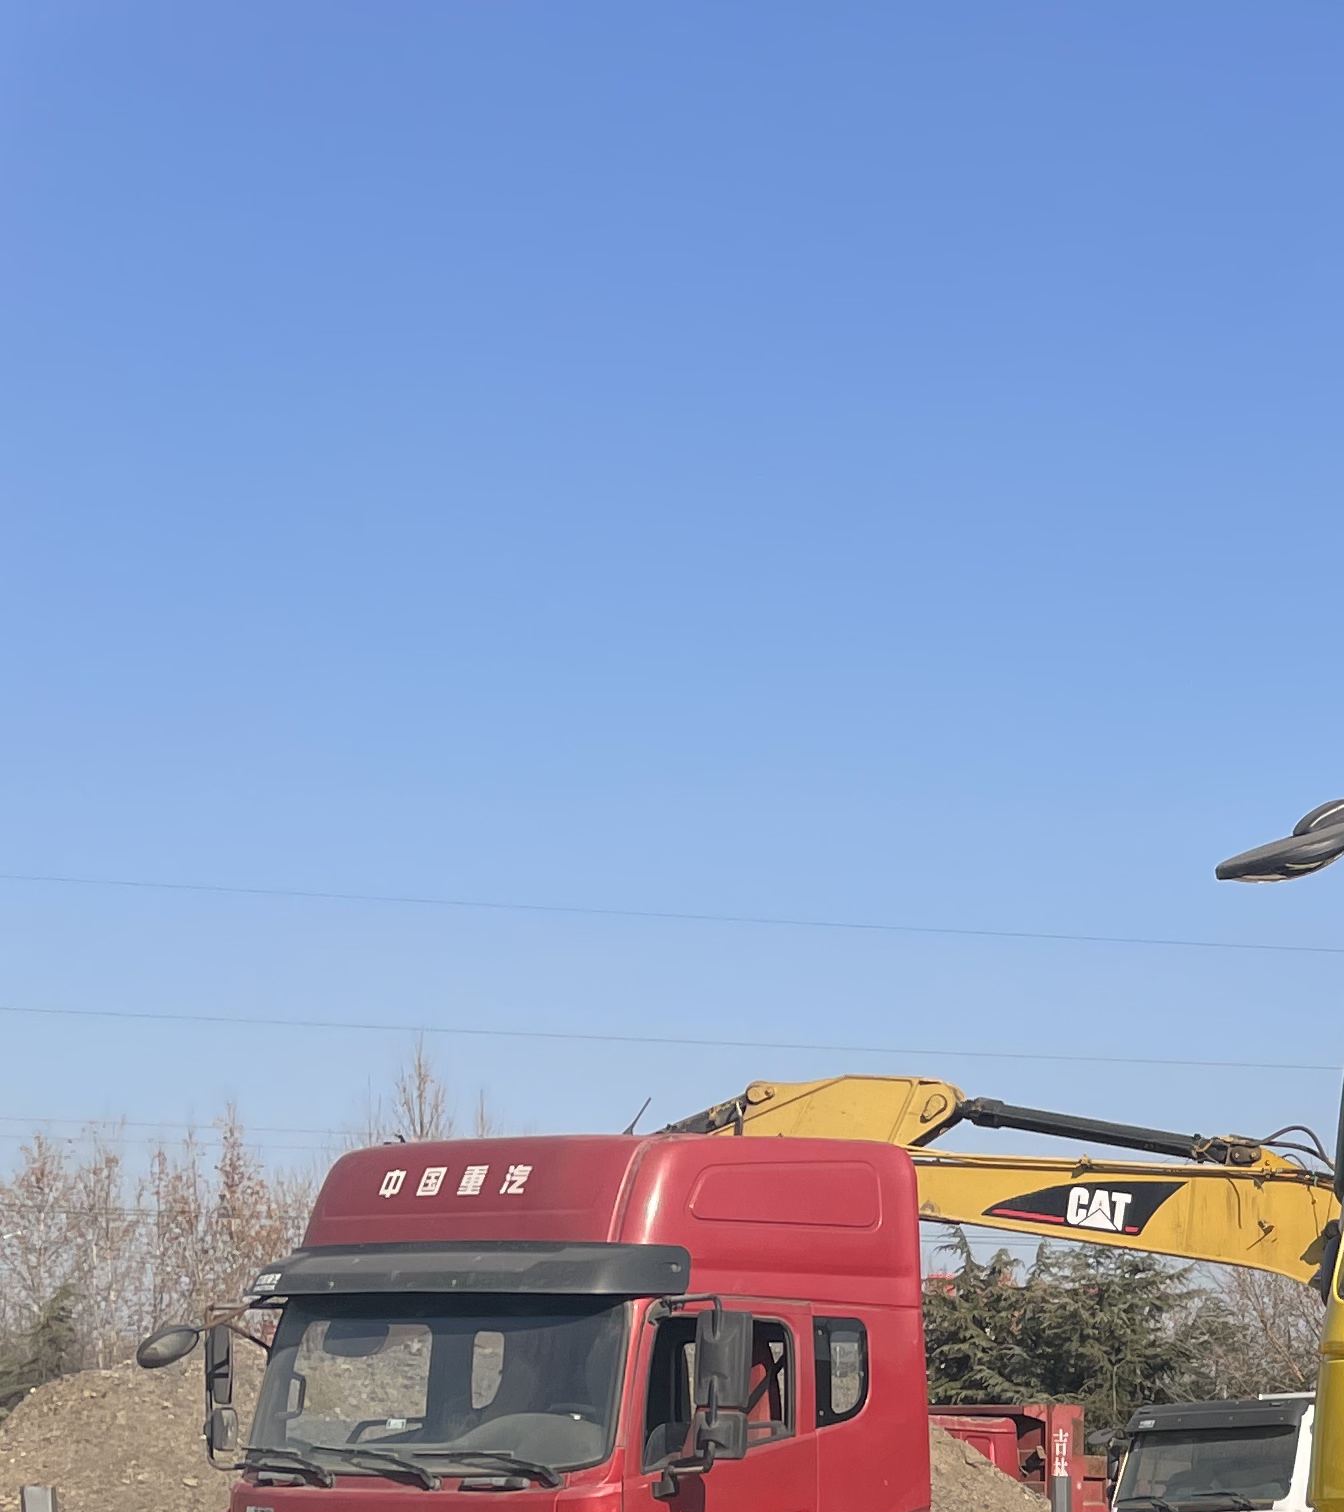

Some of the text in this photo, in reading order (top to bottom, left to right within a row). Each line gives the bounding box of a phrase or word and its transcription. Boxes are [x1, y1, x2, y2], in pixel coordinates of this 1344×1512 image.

[378, 1164, 533, 1199] 中国重汽
[1066, 1186, 1132, 1232] CAT
